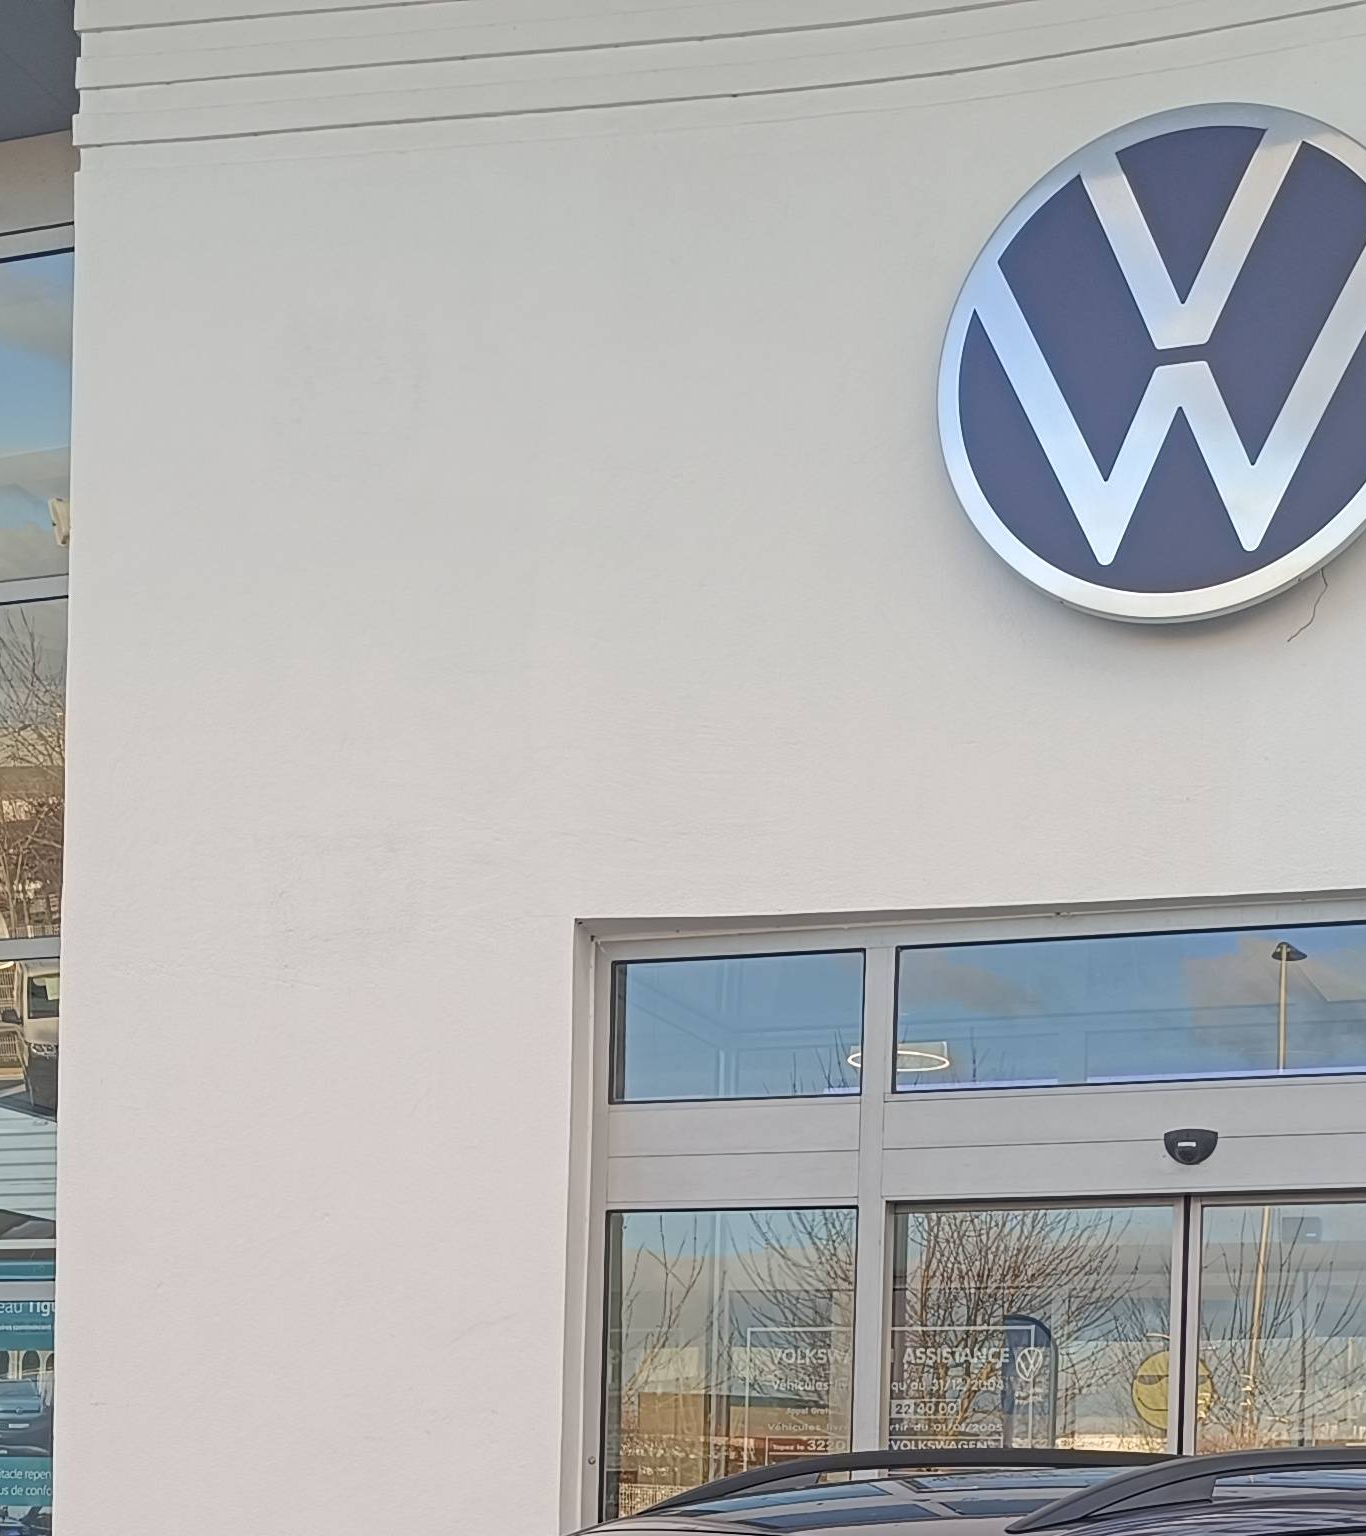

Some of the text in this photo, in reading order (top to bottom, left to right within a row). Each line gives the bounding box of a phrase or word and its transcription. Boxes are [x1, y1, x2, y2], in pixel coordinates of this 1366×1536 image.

[902, 1347, 1010, 1364] ASSISTANCE
[916, 1402, 935, 1414] 40
[938, 1402, 957, 1414] 00
[807, 1439, 846, 1451] 3220
[11, 1485, 23, 1496] de
